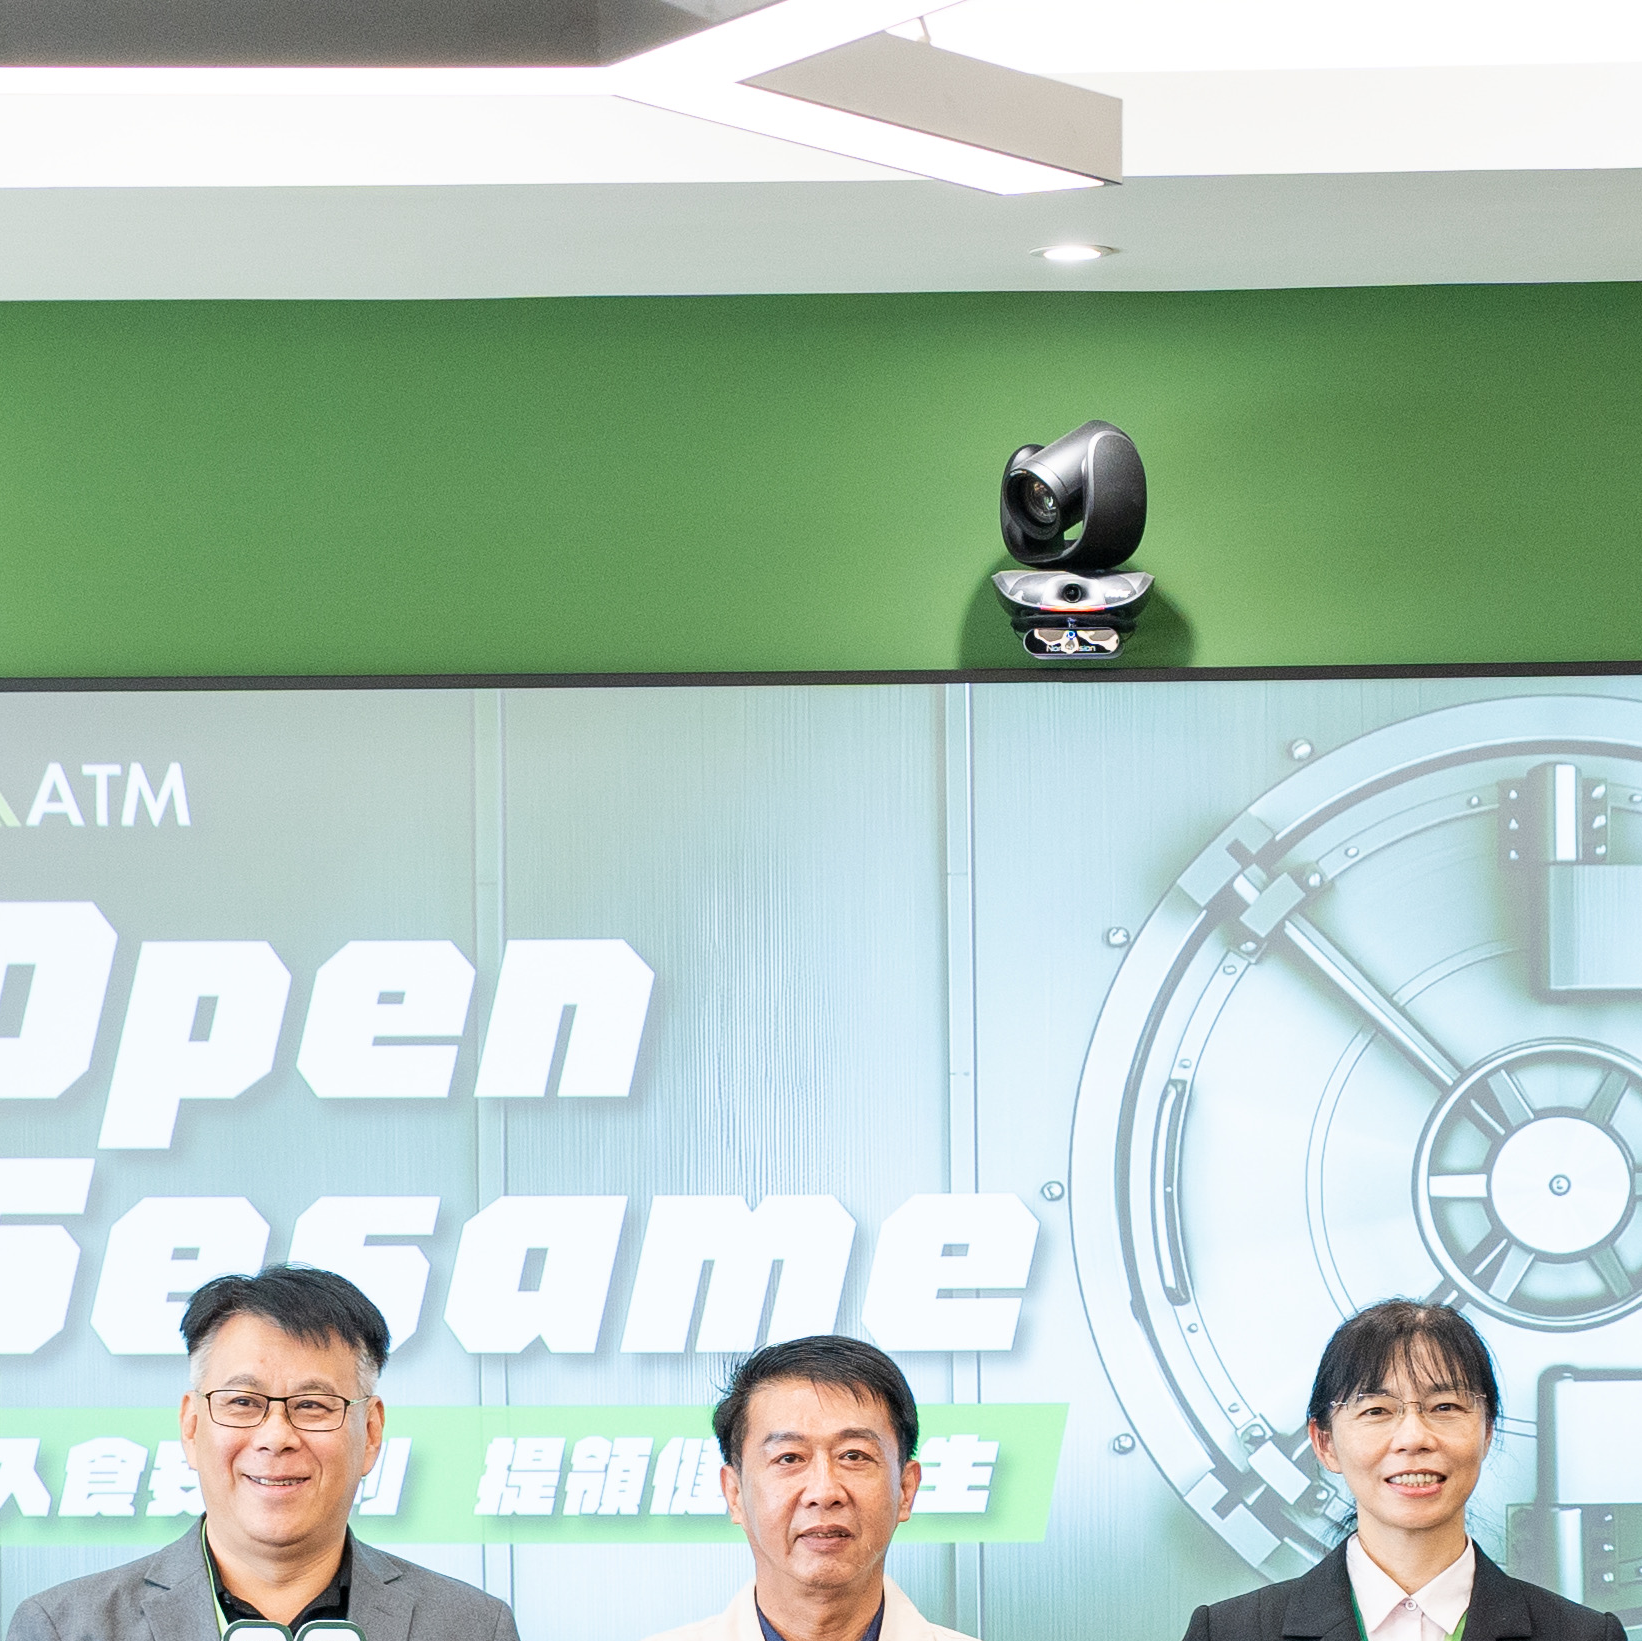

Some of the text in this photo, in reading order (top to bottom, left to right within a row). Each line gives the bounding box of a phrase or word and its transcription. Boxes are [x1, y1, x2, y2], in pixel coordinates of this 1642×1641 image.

[26, 762, 191, 827] ATM
[474, 1434, 1000, 1515] 提領健生
